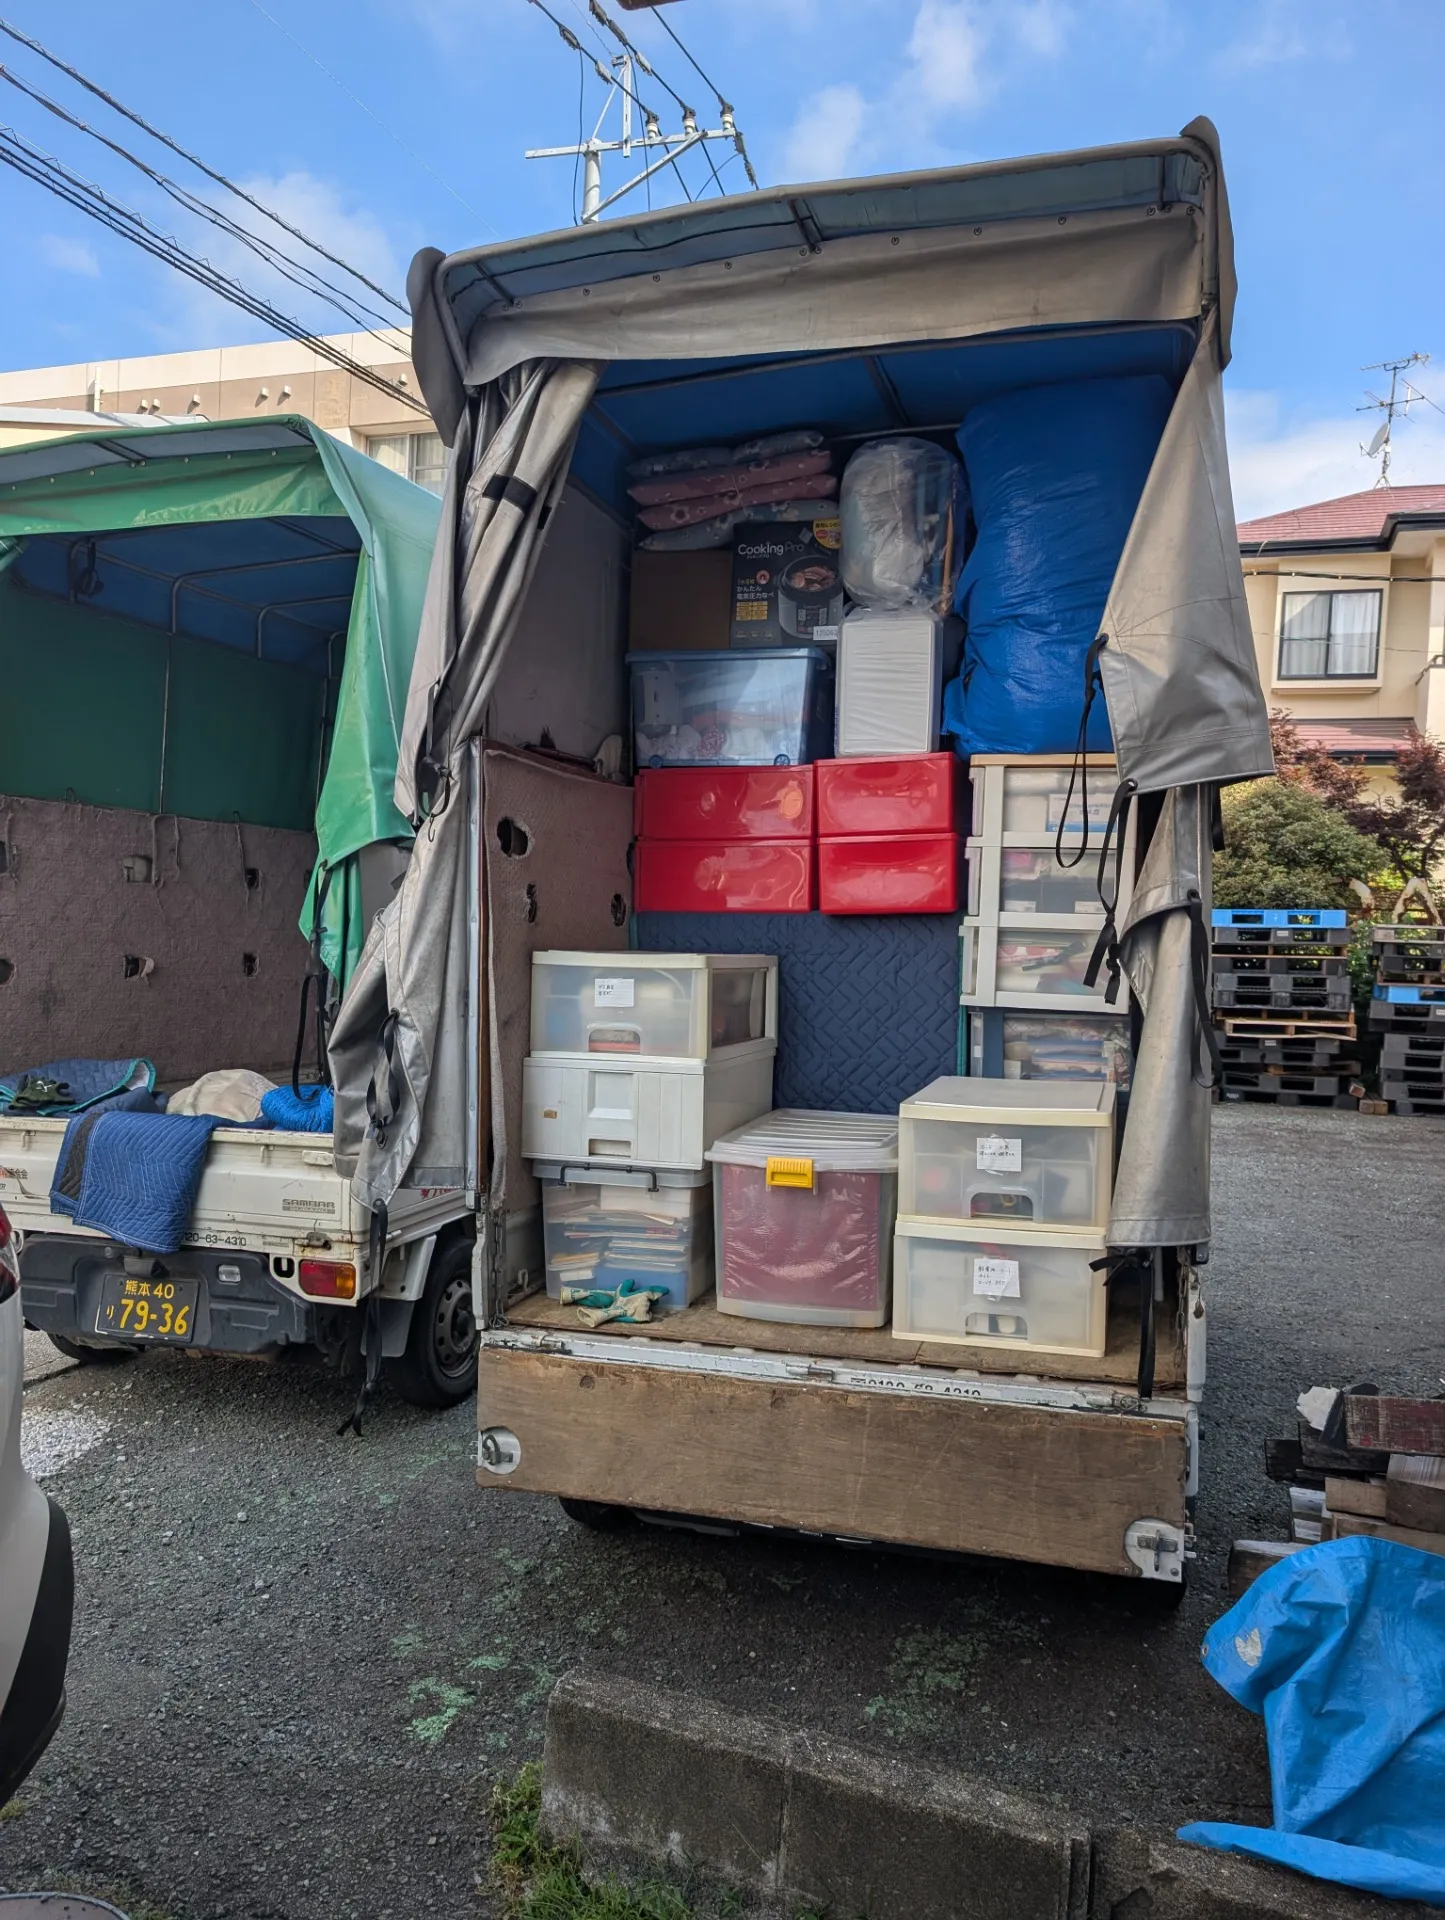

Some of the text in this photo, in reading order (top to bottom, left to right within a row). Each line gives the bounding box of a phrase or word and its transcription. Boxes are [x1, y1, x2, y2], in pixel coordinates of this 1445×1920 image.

[738, 541, 805, 555] Cooking Pro
[737, 592, 775, 600] 電気圧力なべ
[282, 1198, 335, 1209] SAMBAR
[124, 1280, 174, 1299] 熊本 40
[120, 1298, 190, 1335] 79-36
